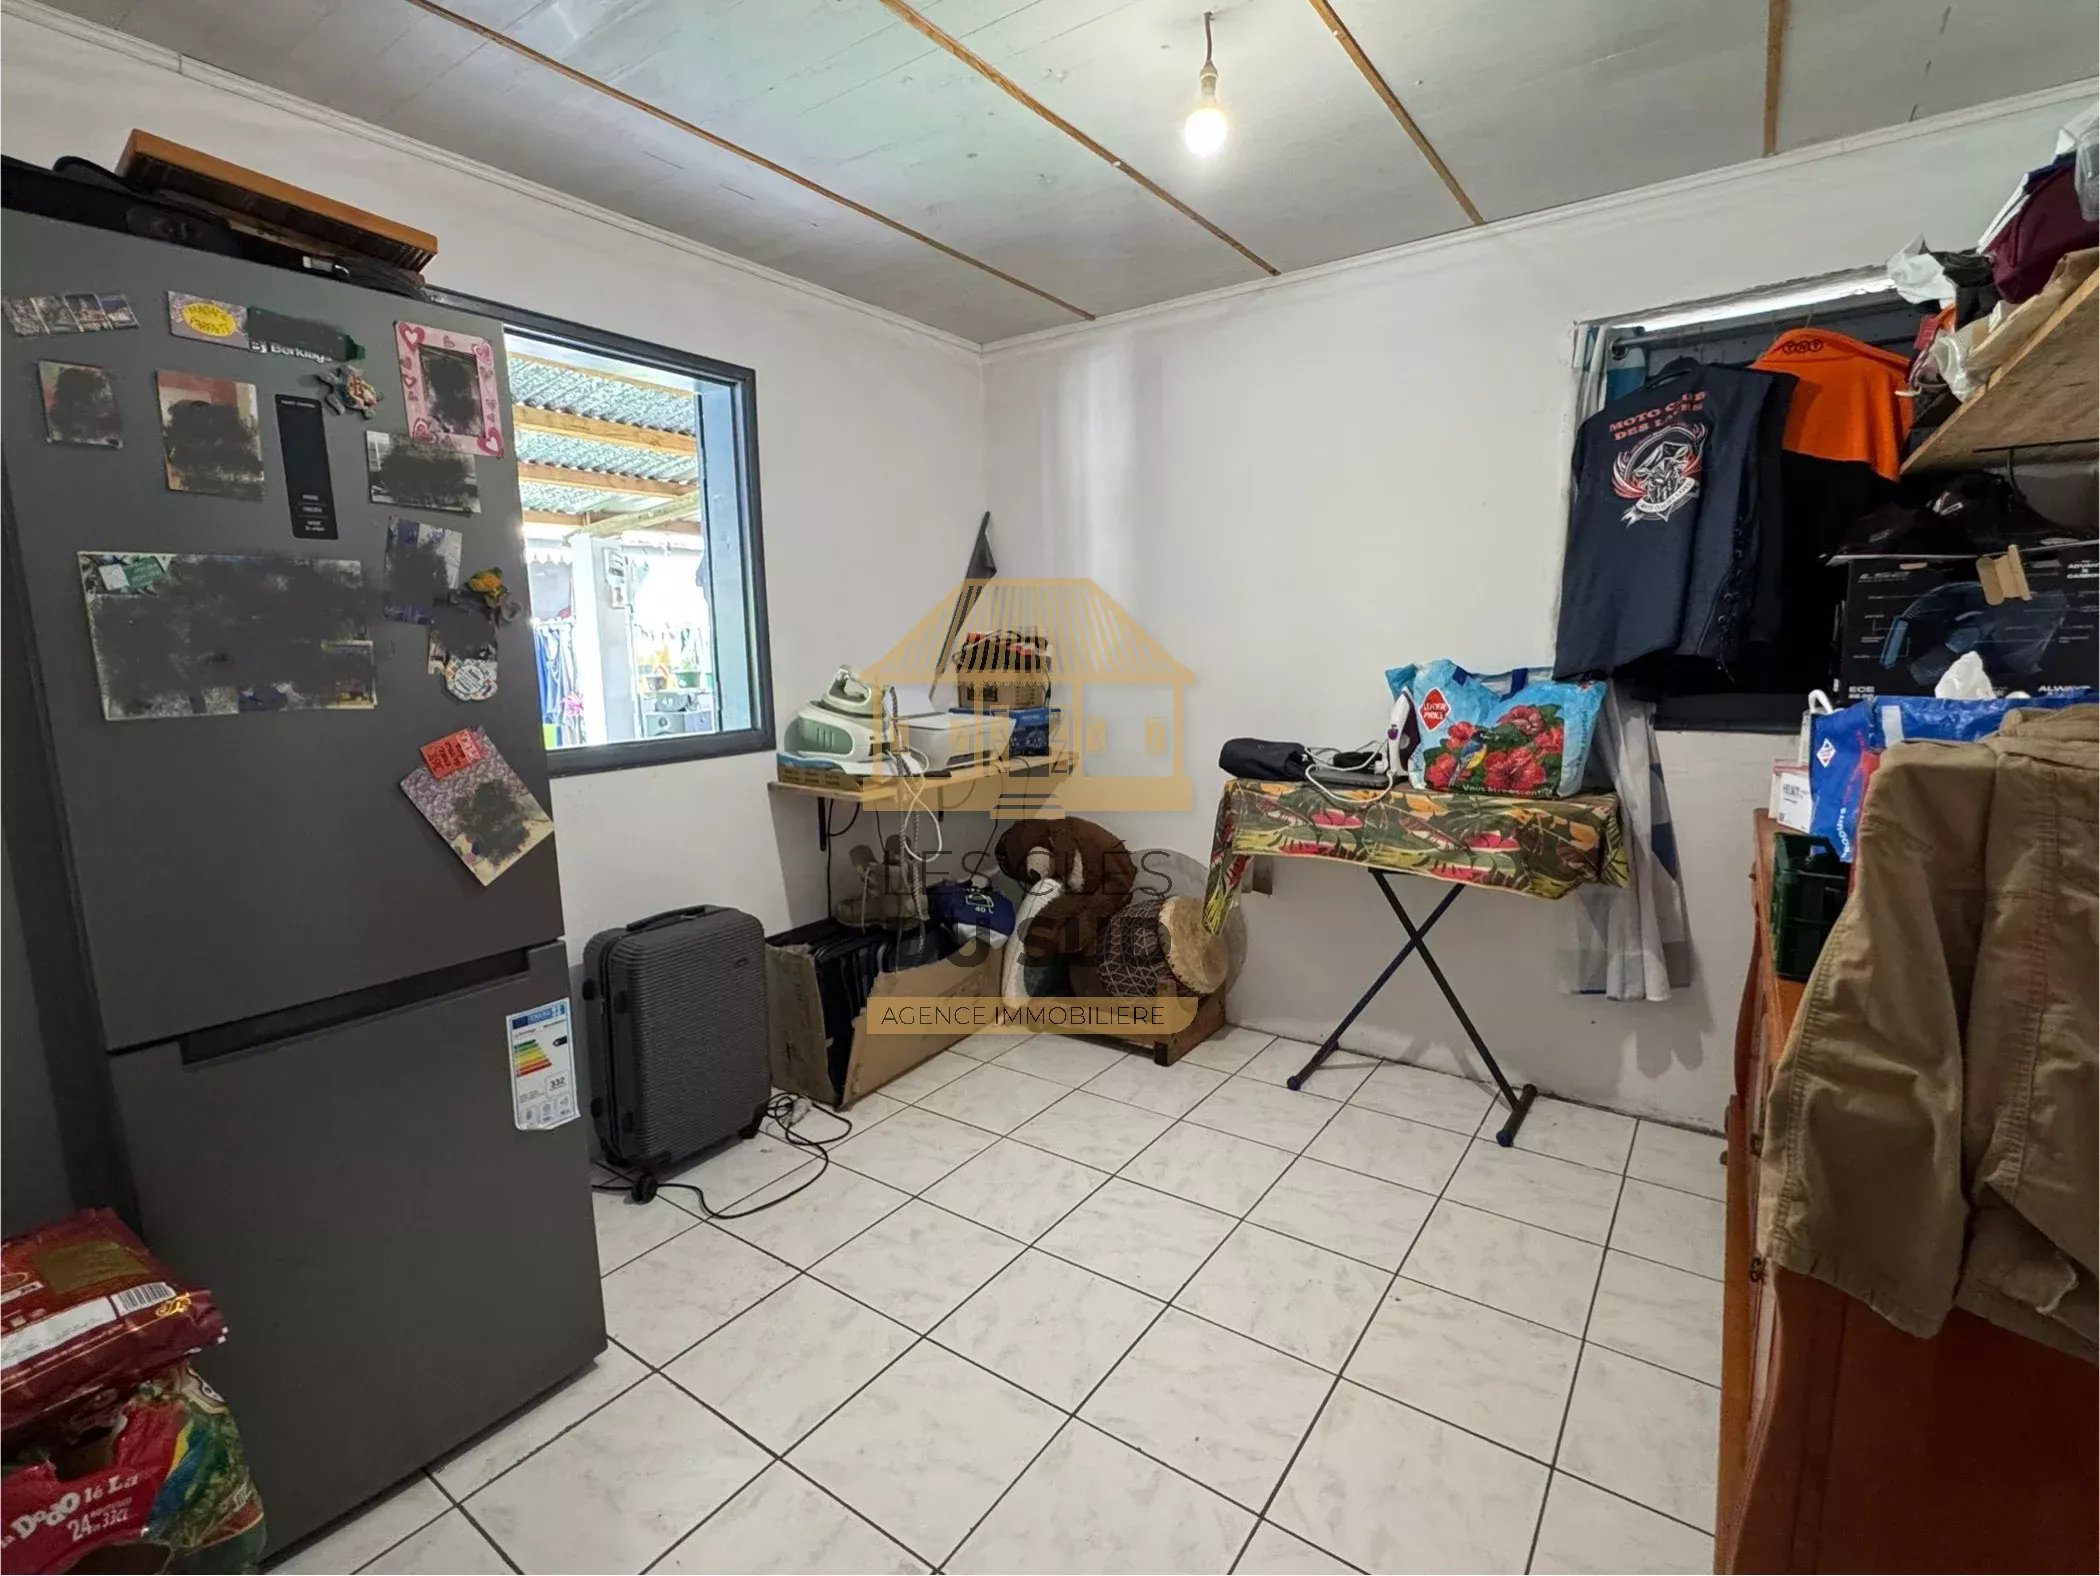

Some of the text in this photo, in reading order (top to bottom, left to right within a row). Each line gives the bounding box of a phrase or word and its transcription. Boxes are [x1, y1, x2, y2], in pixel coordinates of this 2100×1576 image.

[1609, 409, 1660, 432] MOTO
[1615, 423, 1649, 440] DES
[67, 1514, 92, 1541] 24
